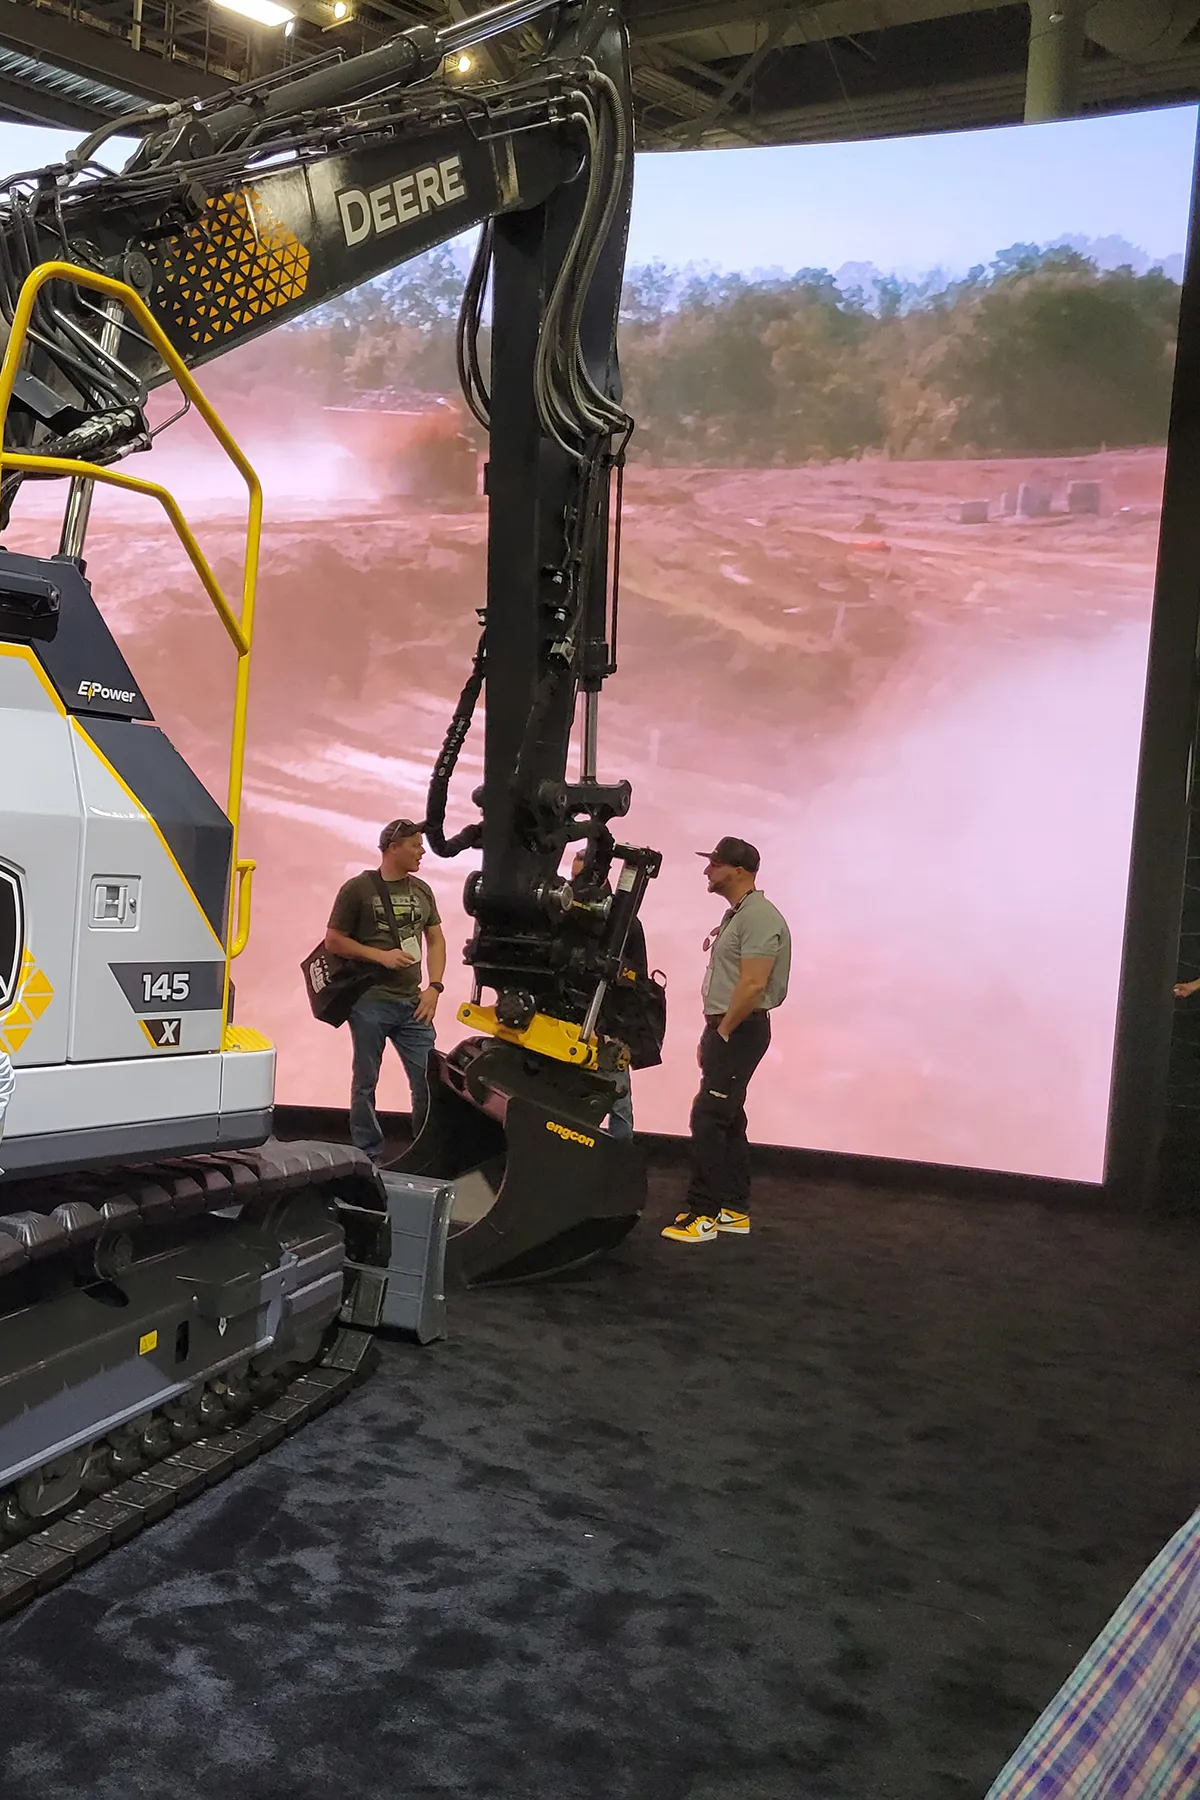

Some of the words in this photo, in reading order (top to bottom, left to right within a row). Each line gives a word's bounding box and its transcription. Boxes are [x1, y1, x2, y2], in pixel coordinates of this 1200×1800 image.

[338, 156, 465, 247] DEERE
[142, 973, 190, 1002] 145
[158, 1020, 180, 1044] X
[545, 1120, 596, 1149] engcon
